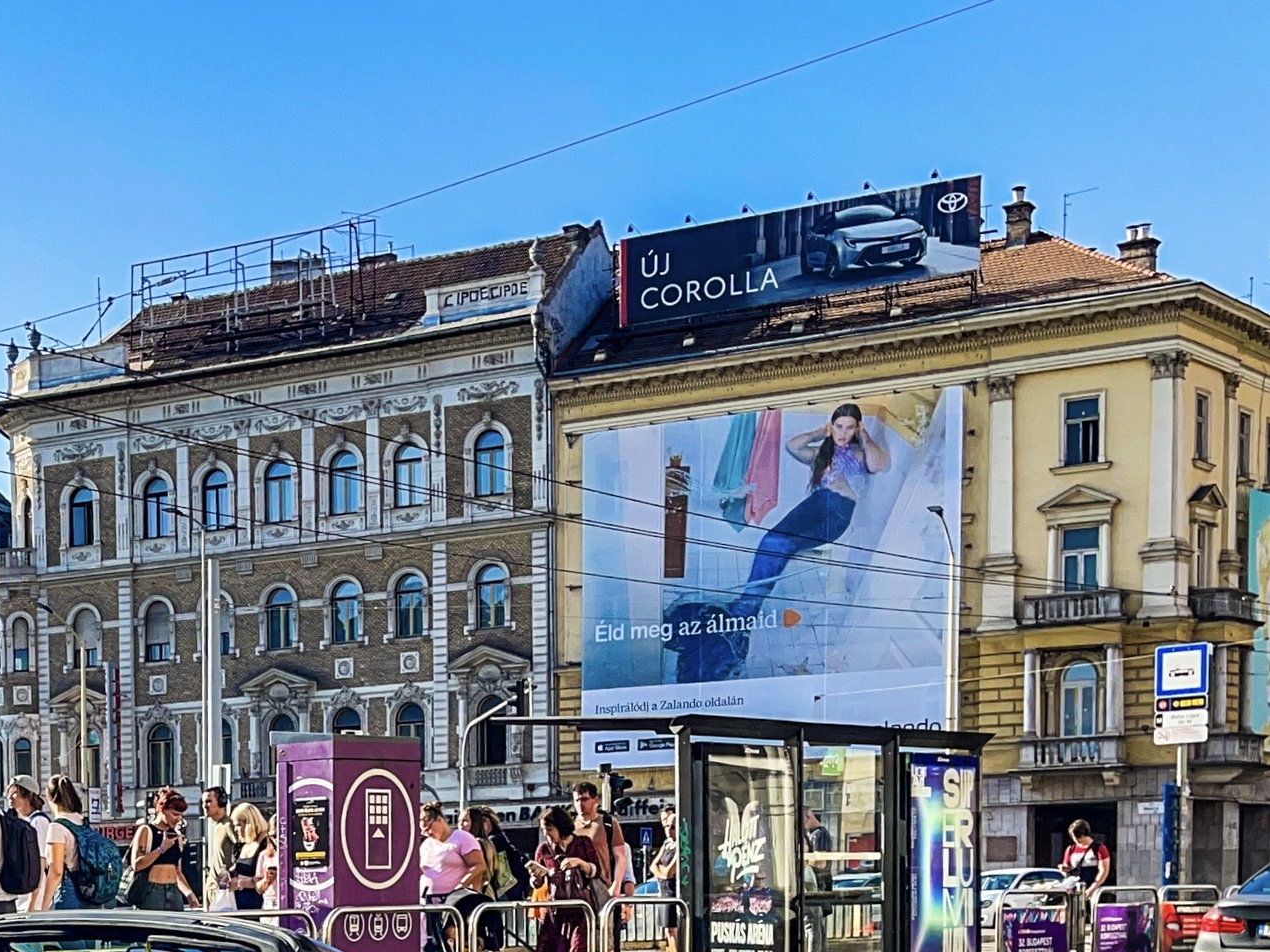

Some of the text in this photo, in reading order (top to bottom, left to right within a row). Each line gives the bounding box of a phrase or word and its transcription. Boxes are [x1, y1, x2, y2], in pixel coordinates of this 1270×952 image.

[641, 249, 670, 278] ÚJ
[640, 267, 779, 310] COROLLA
[595, 610, 778, 642] Éld meg az álmaid
[595, 695, 744, 716] Inspirálódj a Zalando oldalán
[711, 918, 774, 946] PUSKÁS ARÉNA
